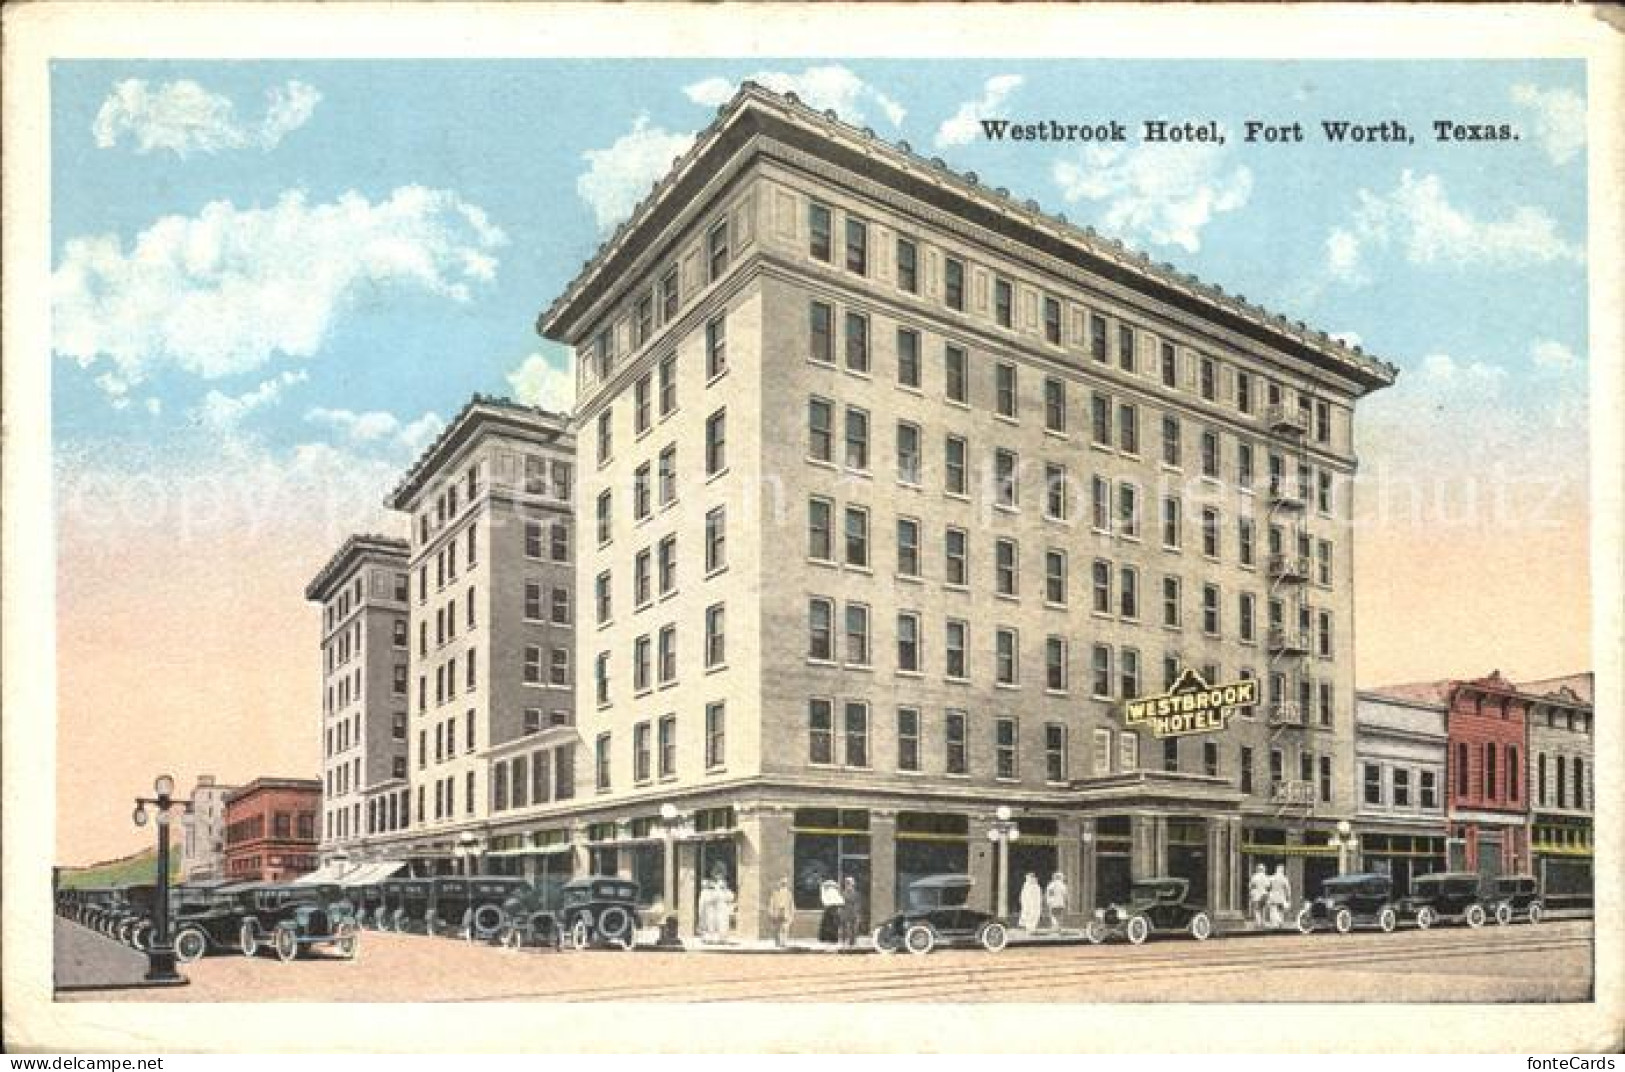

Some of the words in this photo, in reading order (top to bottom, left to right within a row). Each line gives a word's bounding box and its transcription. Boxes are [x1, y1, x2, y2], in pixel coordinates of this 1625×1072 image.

[980, 120, 1126, 142] Westbrook
[1144, 120, 1225, 145] Hotel,
[1244, 121, 1303, 142] Fort
[1322, 120, 1415, 144] Worth,
[1434, 120, 1520, 142] Texas.
[1128, 683, 1253, 718] WESTBROOK
[1154, 708, 1222, 733] HOTEL
